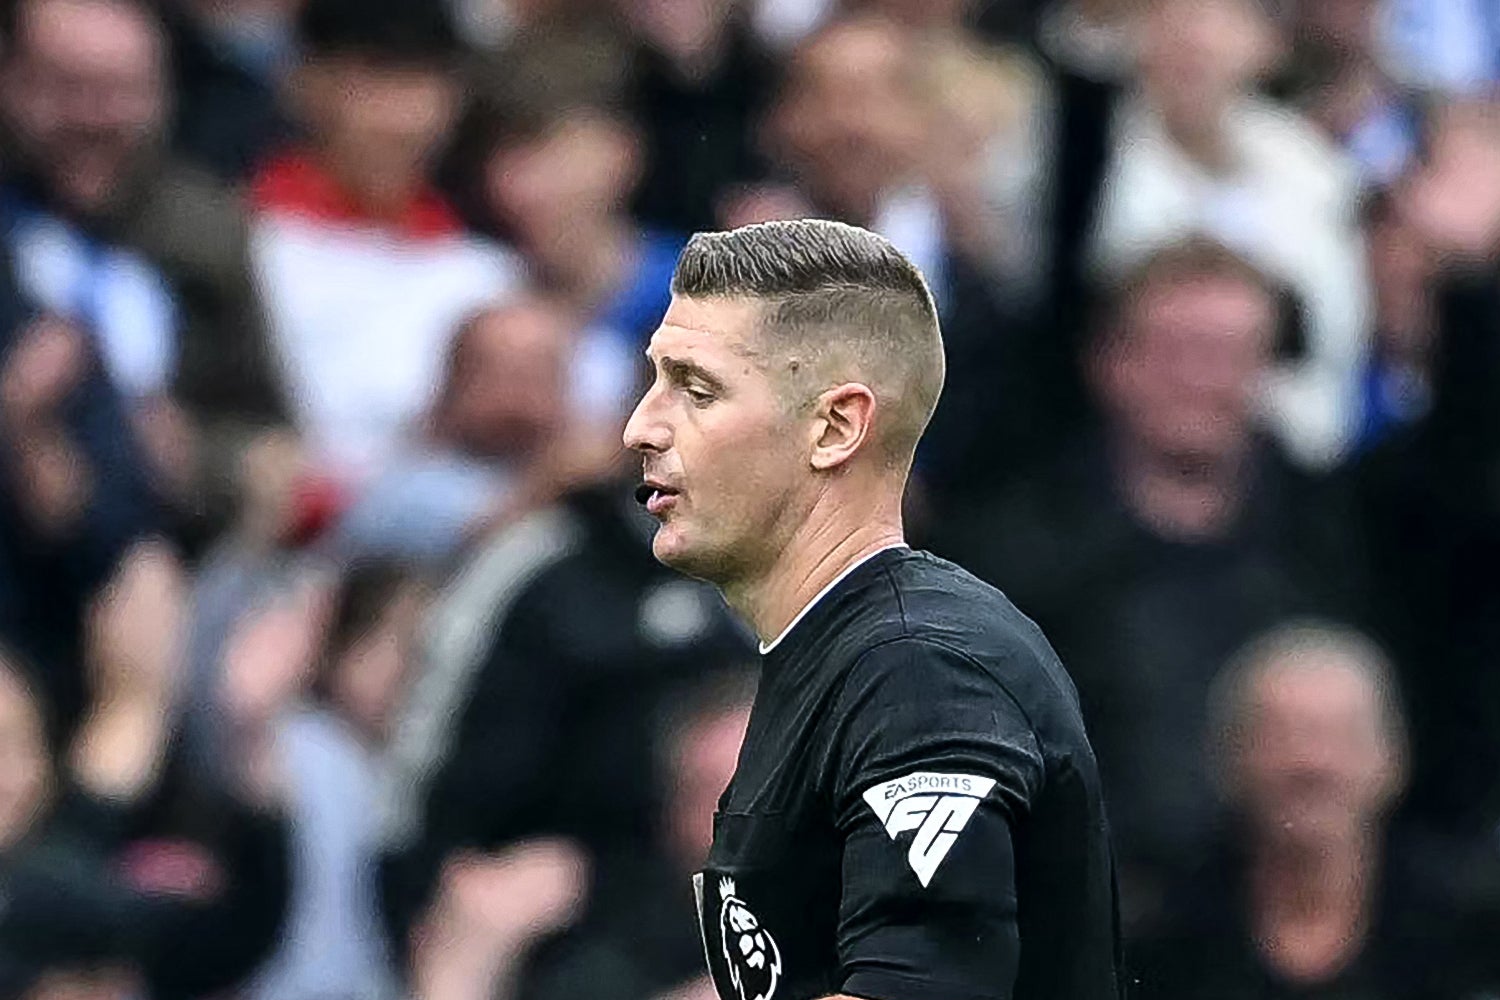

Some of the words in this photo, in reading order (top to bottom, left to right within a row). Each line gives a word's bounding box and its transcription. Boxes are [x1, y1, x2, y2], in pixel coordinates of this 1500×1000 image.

[884, 783, 907, 800] EA
[907, 775, 972, 792] SPORTS
[884, 794, 981, 889] FC
